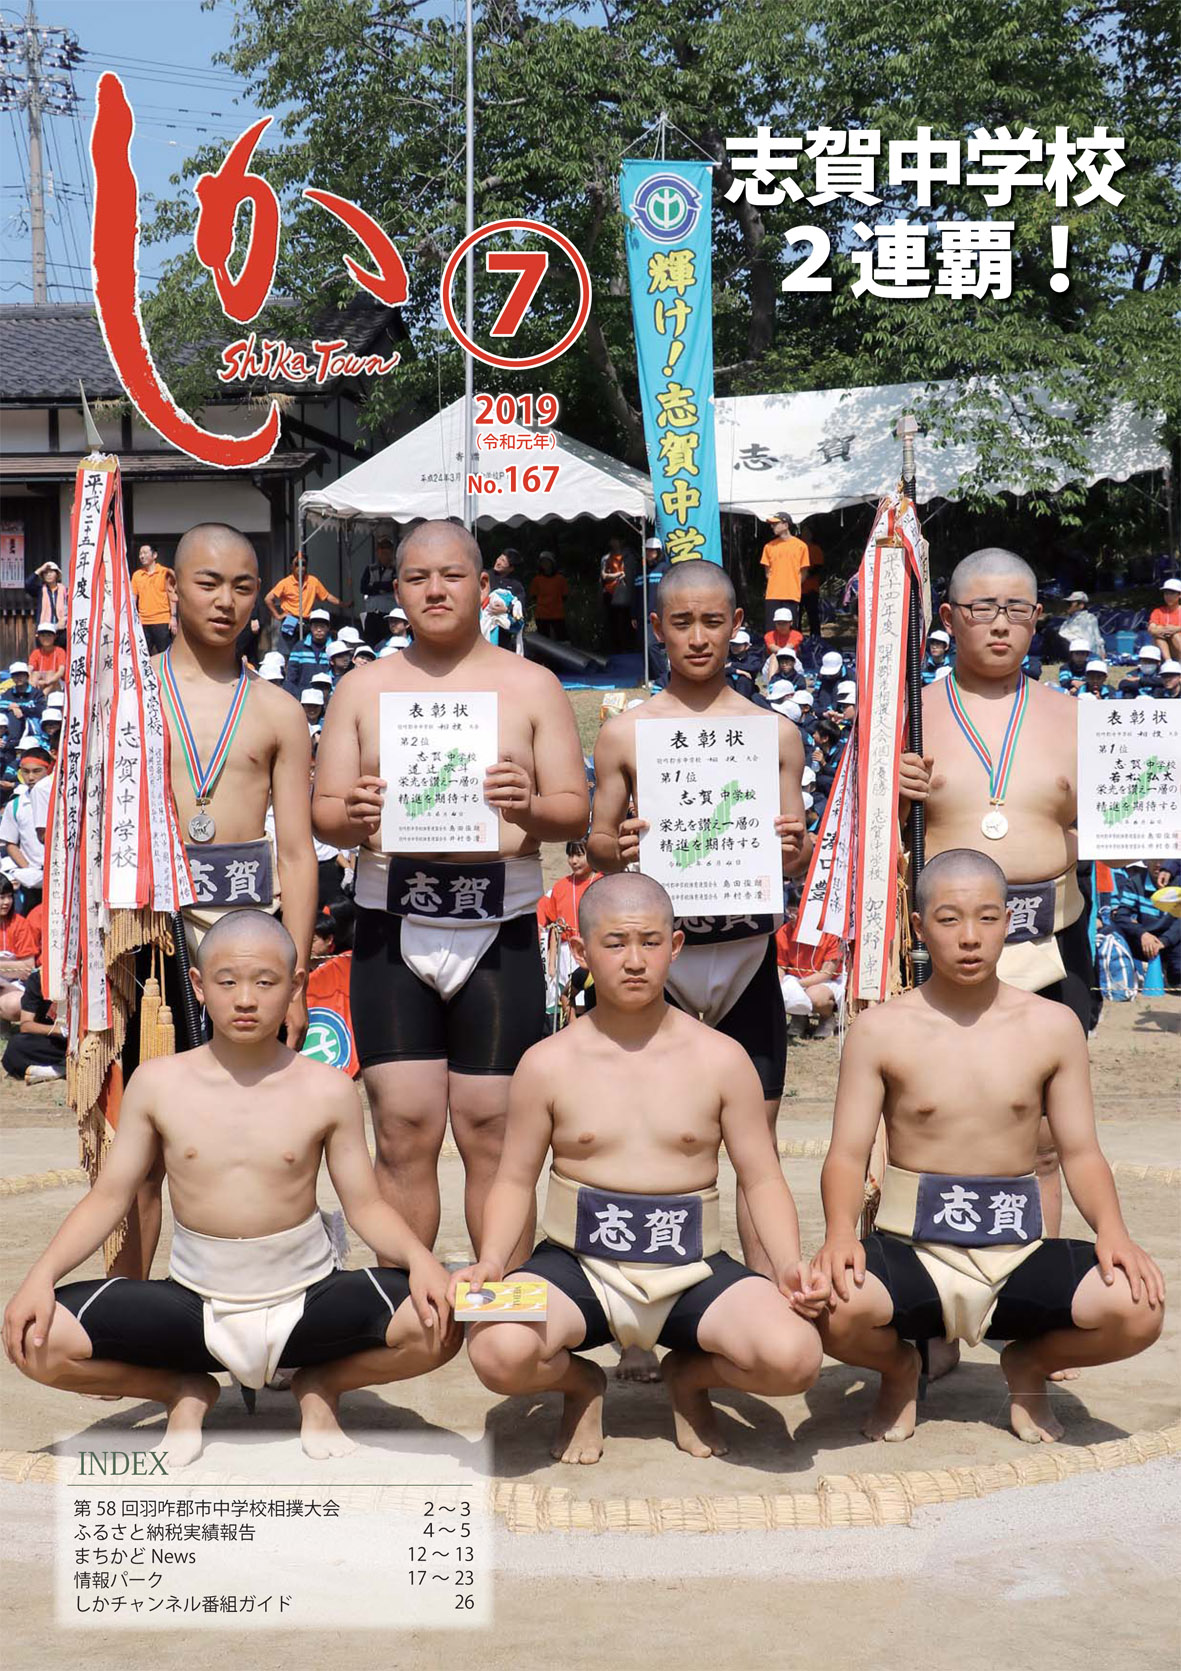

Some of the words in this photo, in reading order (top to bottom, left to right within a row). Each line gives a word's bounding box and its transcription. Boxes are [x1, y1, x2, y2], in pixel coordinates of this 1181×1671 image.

[408, 702, 469, 718] 表彰状
[1107, 709, 1169, 725] 表彰状
[400, 736, 430, 748] 第2位
[669, 728, 745, 748] 表彰状
[1098, 743, 1129, 755] 第1位
[660, 769, 697, 784] 第1位
[398, 793, 479, 806] 精進を期待する
[679, 788, 757, 806] 志賀中学校
[1096, 800, 1178, 813] 精進を期待する
[659, 816, 760, 833] 栄光を讃え一層の
[659, 838, 761, 853] 精進を期待する
[190, 858, 262, 903] 志賀
[400, 870, 491, 920] 志賀
[932, 1184, 1029, 1241] 志賀
[588, 1203, 689, 1257] 志賀
